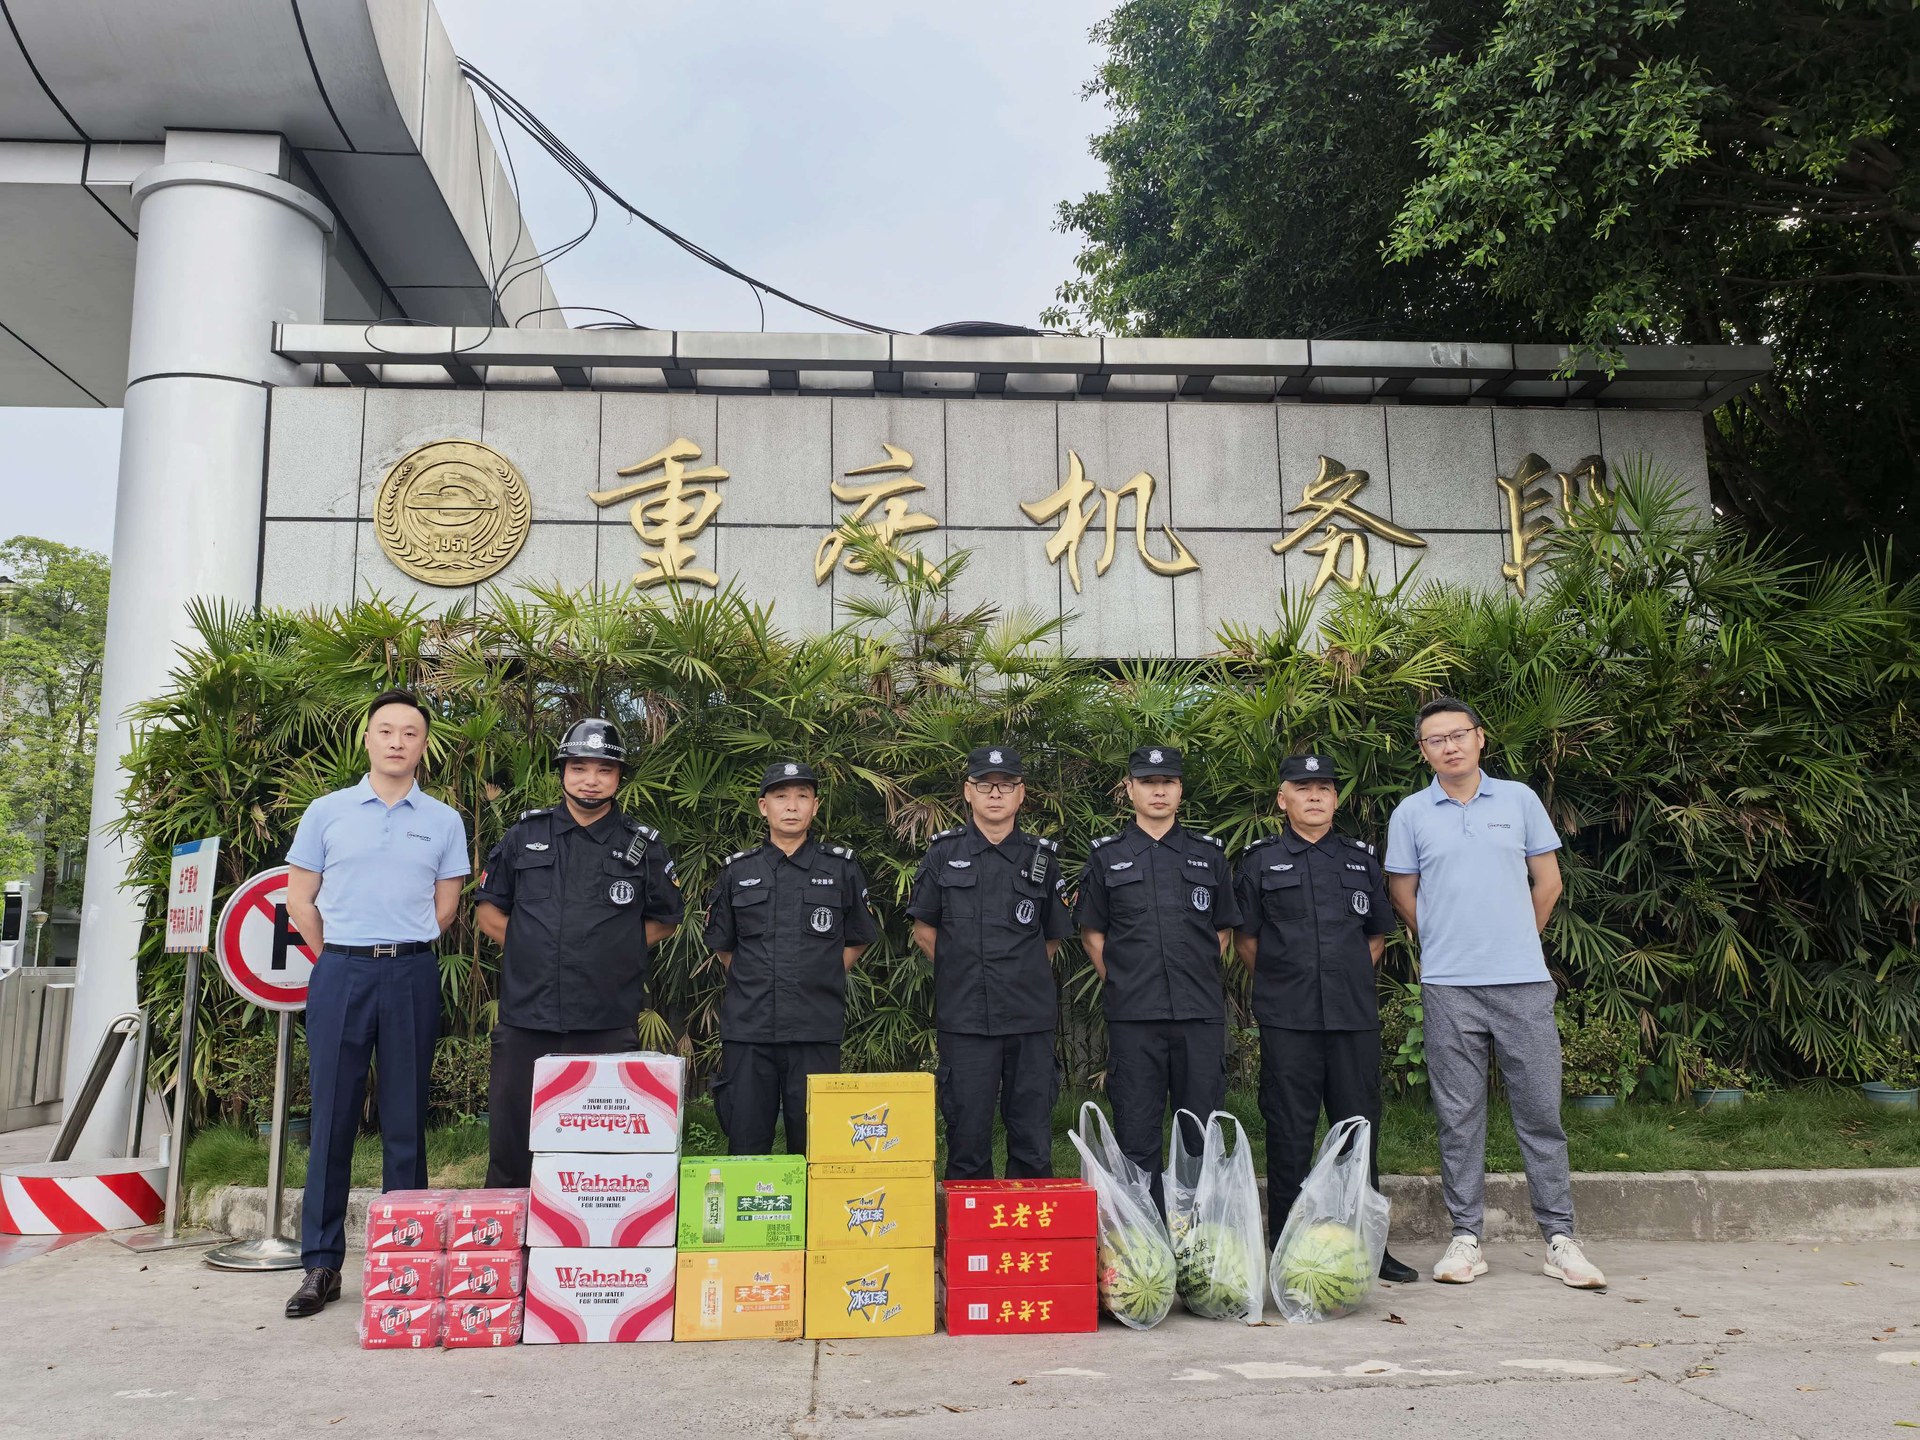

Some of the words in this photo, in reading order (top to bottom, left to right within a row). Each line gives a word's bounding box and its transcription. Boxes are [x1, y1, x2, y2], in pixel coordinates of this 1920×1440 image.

[433, 537, 468, 552] 1951
[559, 1113, 650, 1134] Wahaha
[852, 1123, 888, 1146] 冰红茶
[557, 1171, 650, 1193] Wahaha
[738, 1195, 791, 1211] 茉莉清茶
[847, 1208, 884, 1231] 冰红茶
[989, 1202, 1054, 1228] 王老吉
[999, 1251, 1053, 1274] 王老吉
[555, 1267, 648, 1288] Wahaha
[847, 1289, 888, 1316] 冰红茶
[1000, 1300, 1053, 1323] 王老吉
